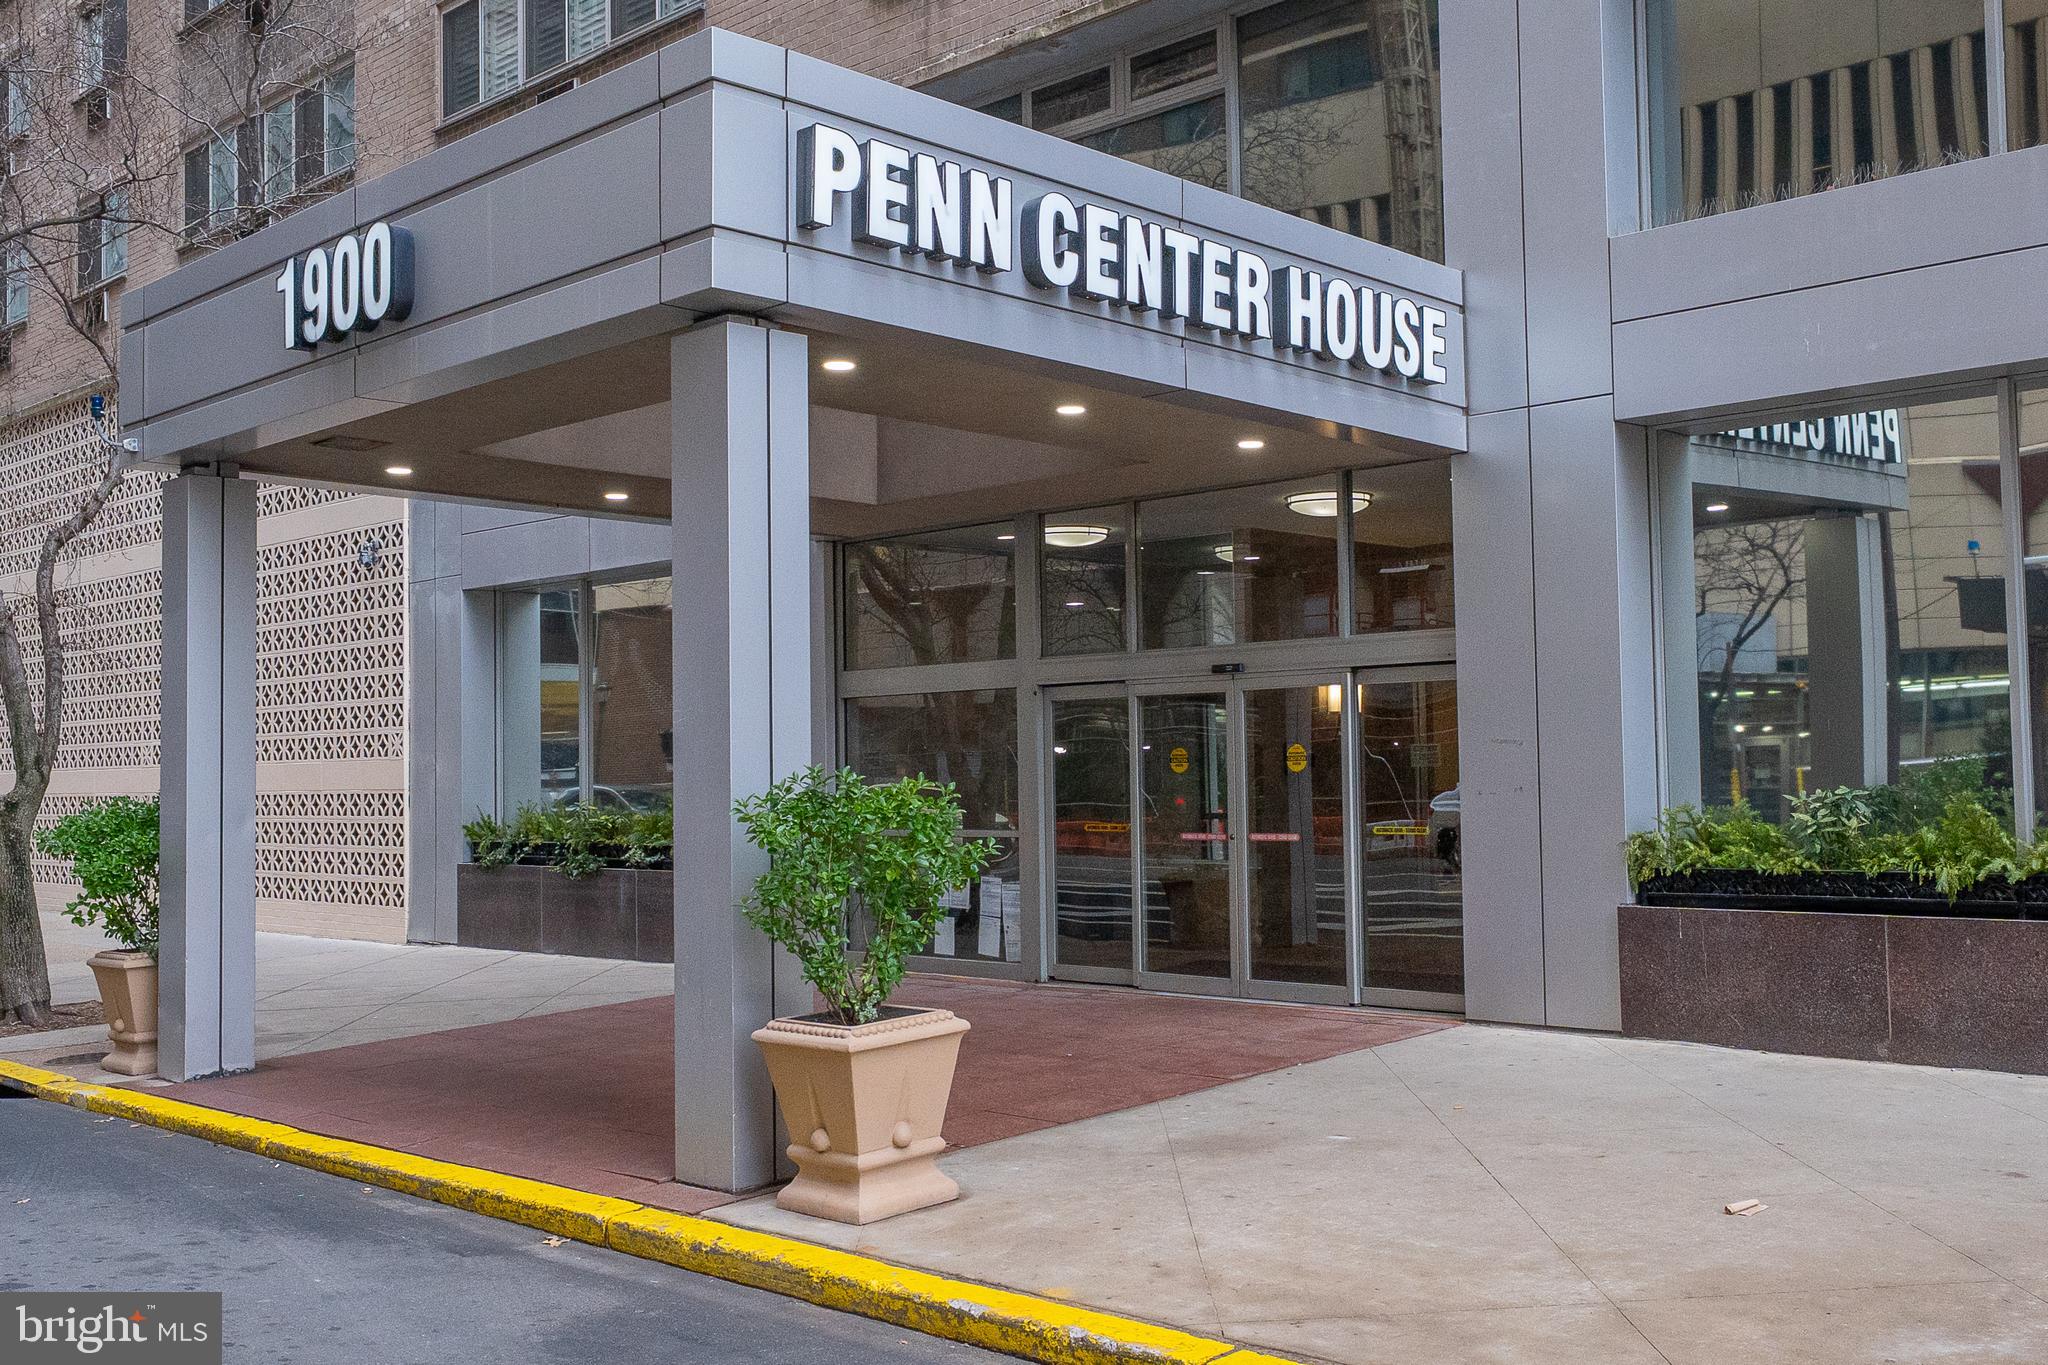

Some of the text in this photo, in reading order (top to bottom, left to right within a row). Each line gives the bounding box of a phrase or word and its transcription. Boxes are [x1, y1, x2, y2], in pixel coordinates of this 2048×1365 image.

[276, 221, 392, 351] 1900
[812, 122, 1448, 385] PENN CENTER HOUSE
